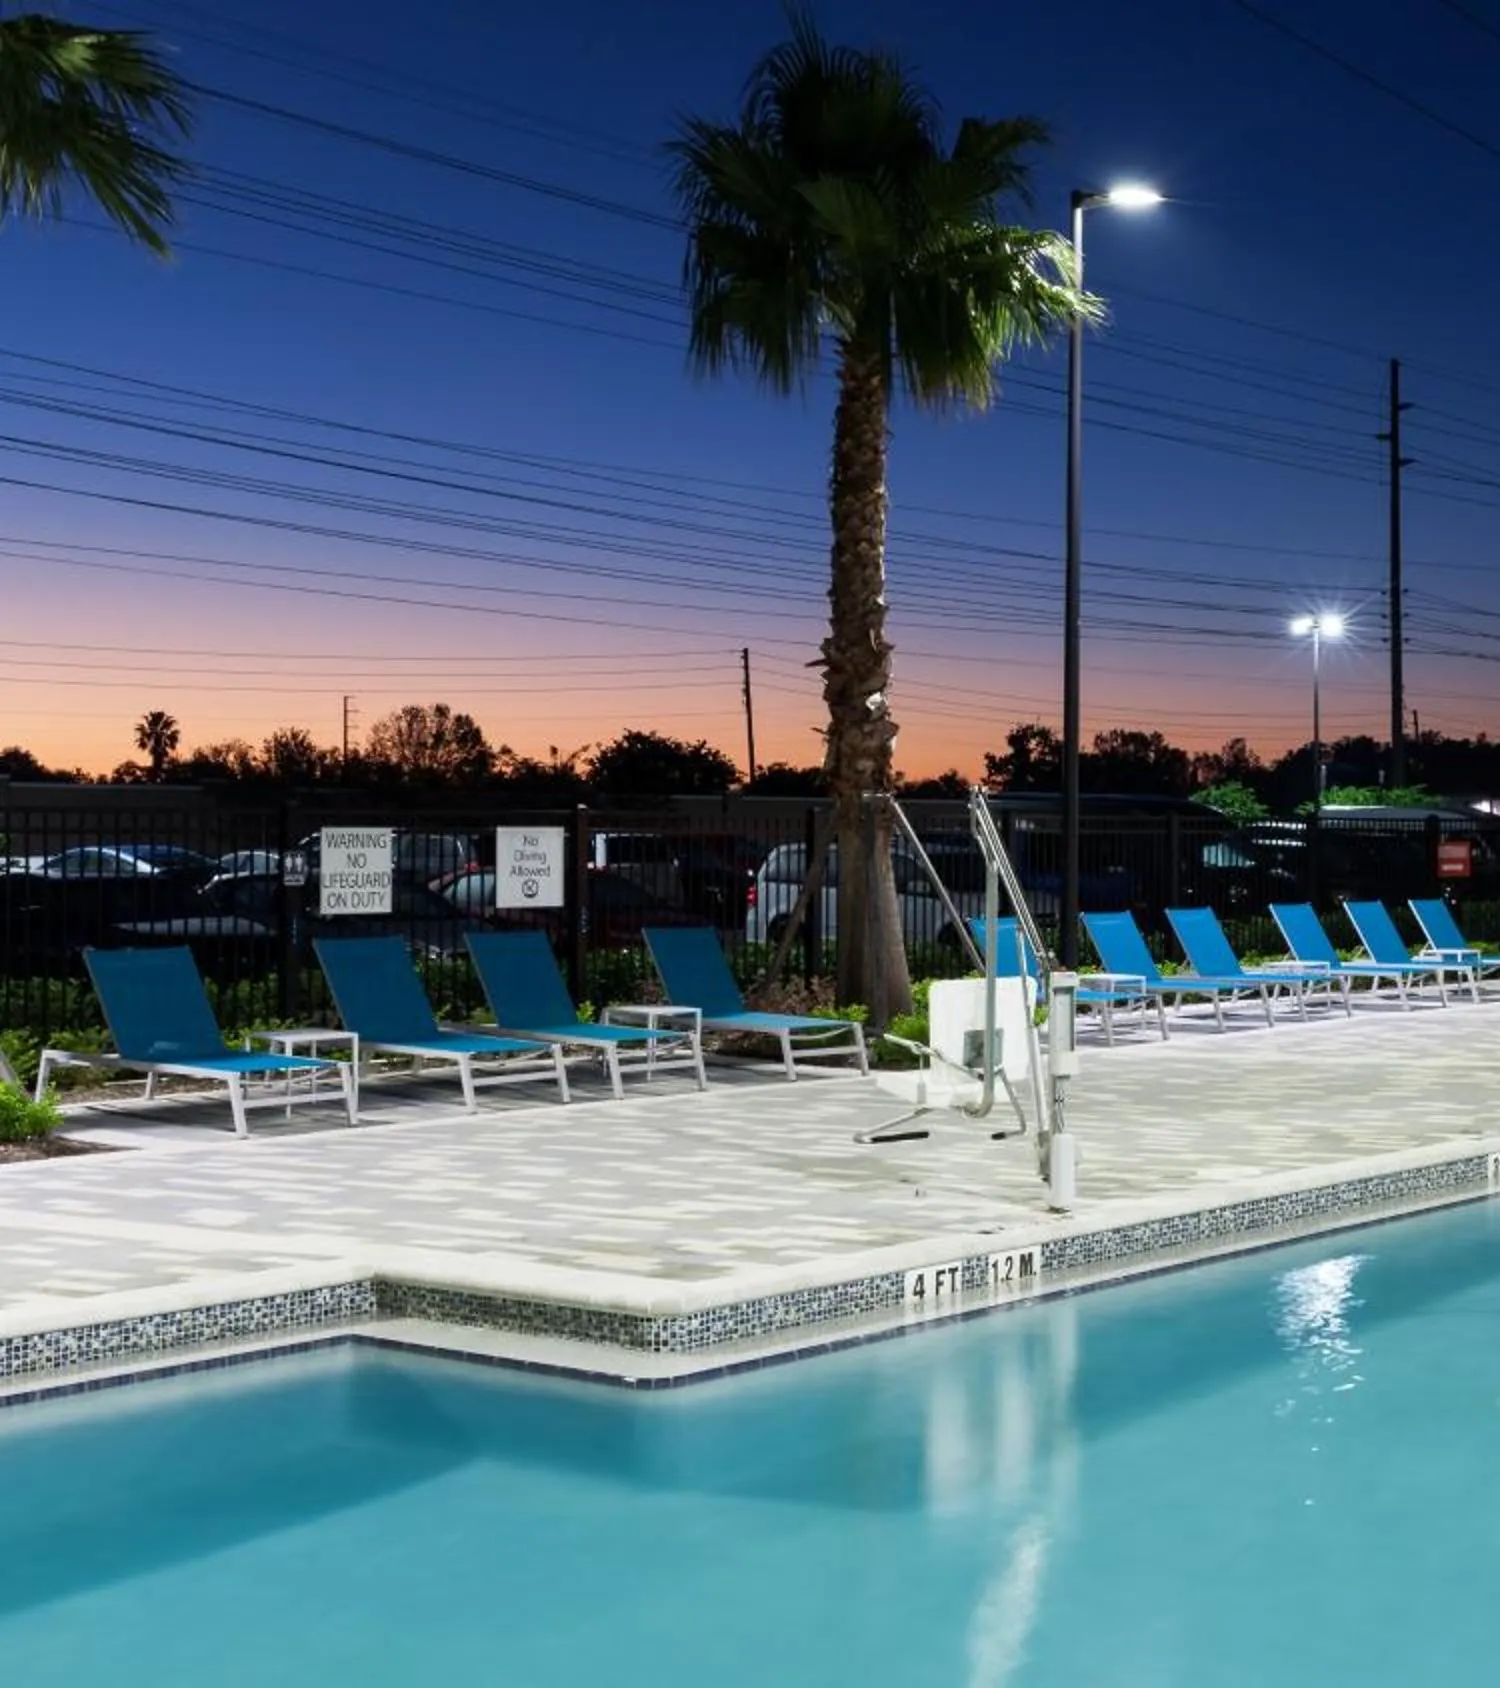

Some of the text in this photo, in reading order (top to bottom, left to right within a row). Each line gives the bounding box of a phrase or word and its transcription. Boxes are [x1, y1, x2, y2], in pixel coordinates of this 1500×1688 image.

[325, 832, 387, 849] WARNING
[523, 834, 539, 847] No
[346, 853, 367, 869] NO
[510, 865, 551, 877] Allowed
[321, 872, 391, 889] LIFEGUARD
[327, 891, 386, 909] ON DUTY
[913, 1266, 958, 1300] 4 FT
